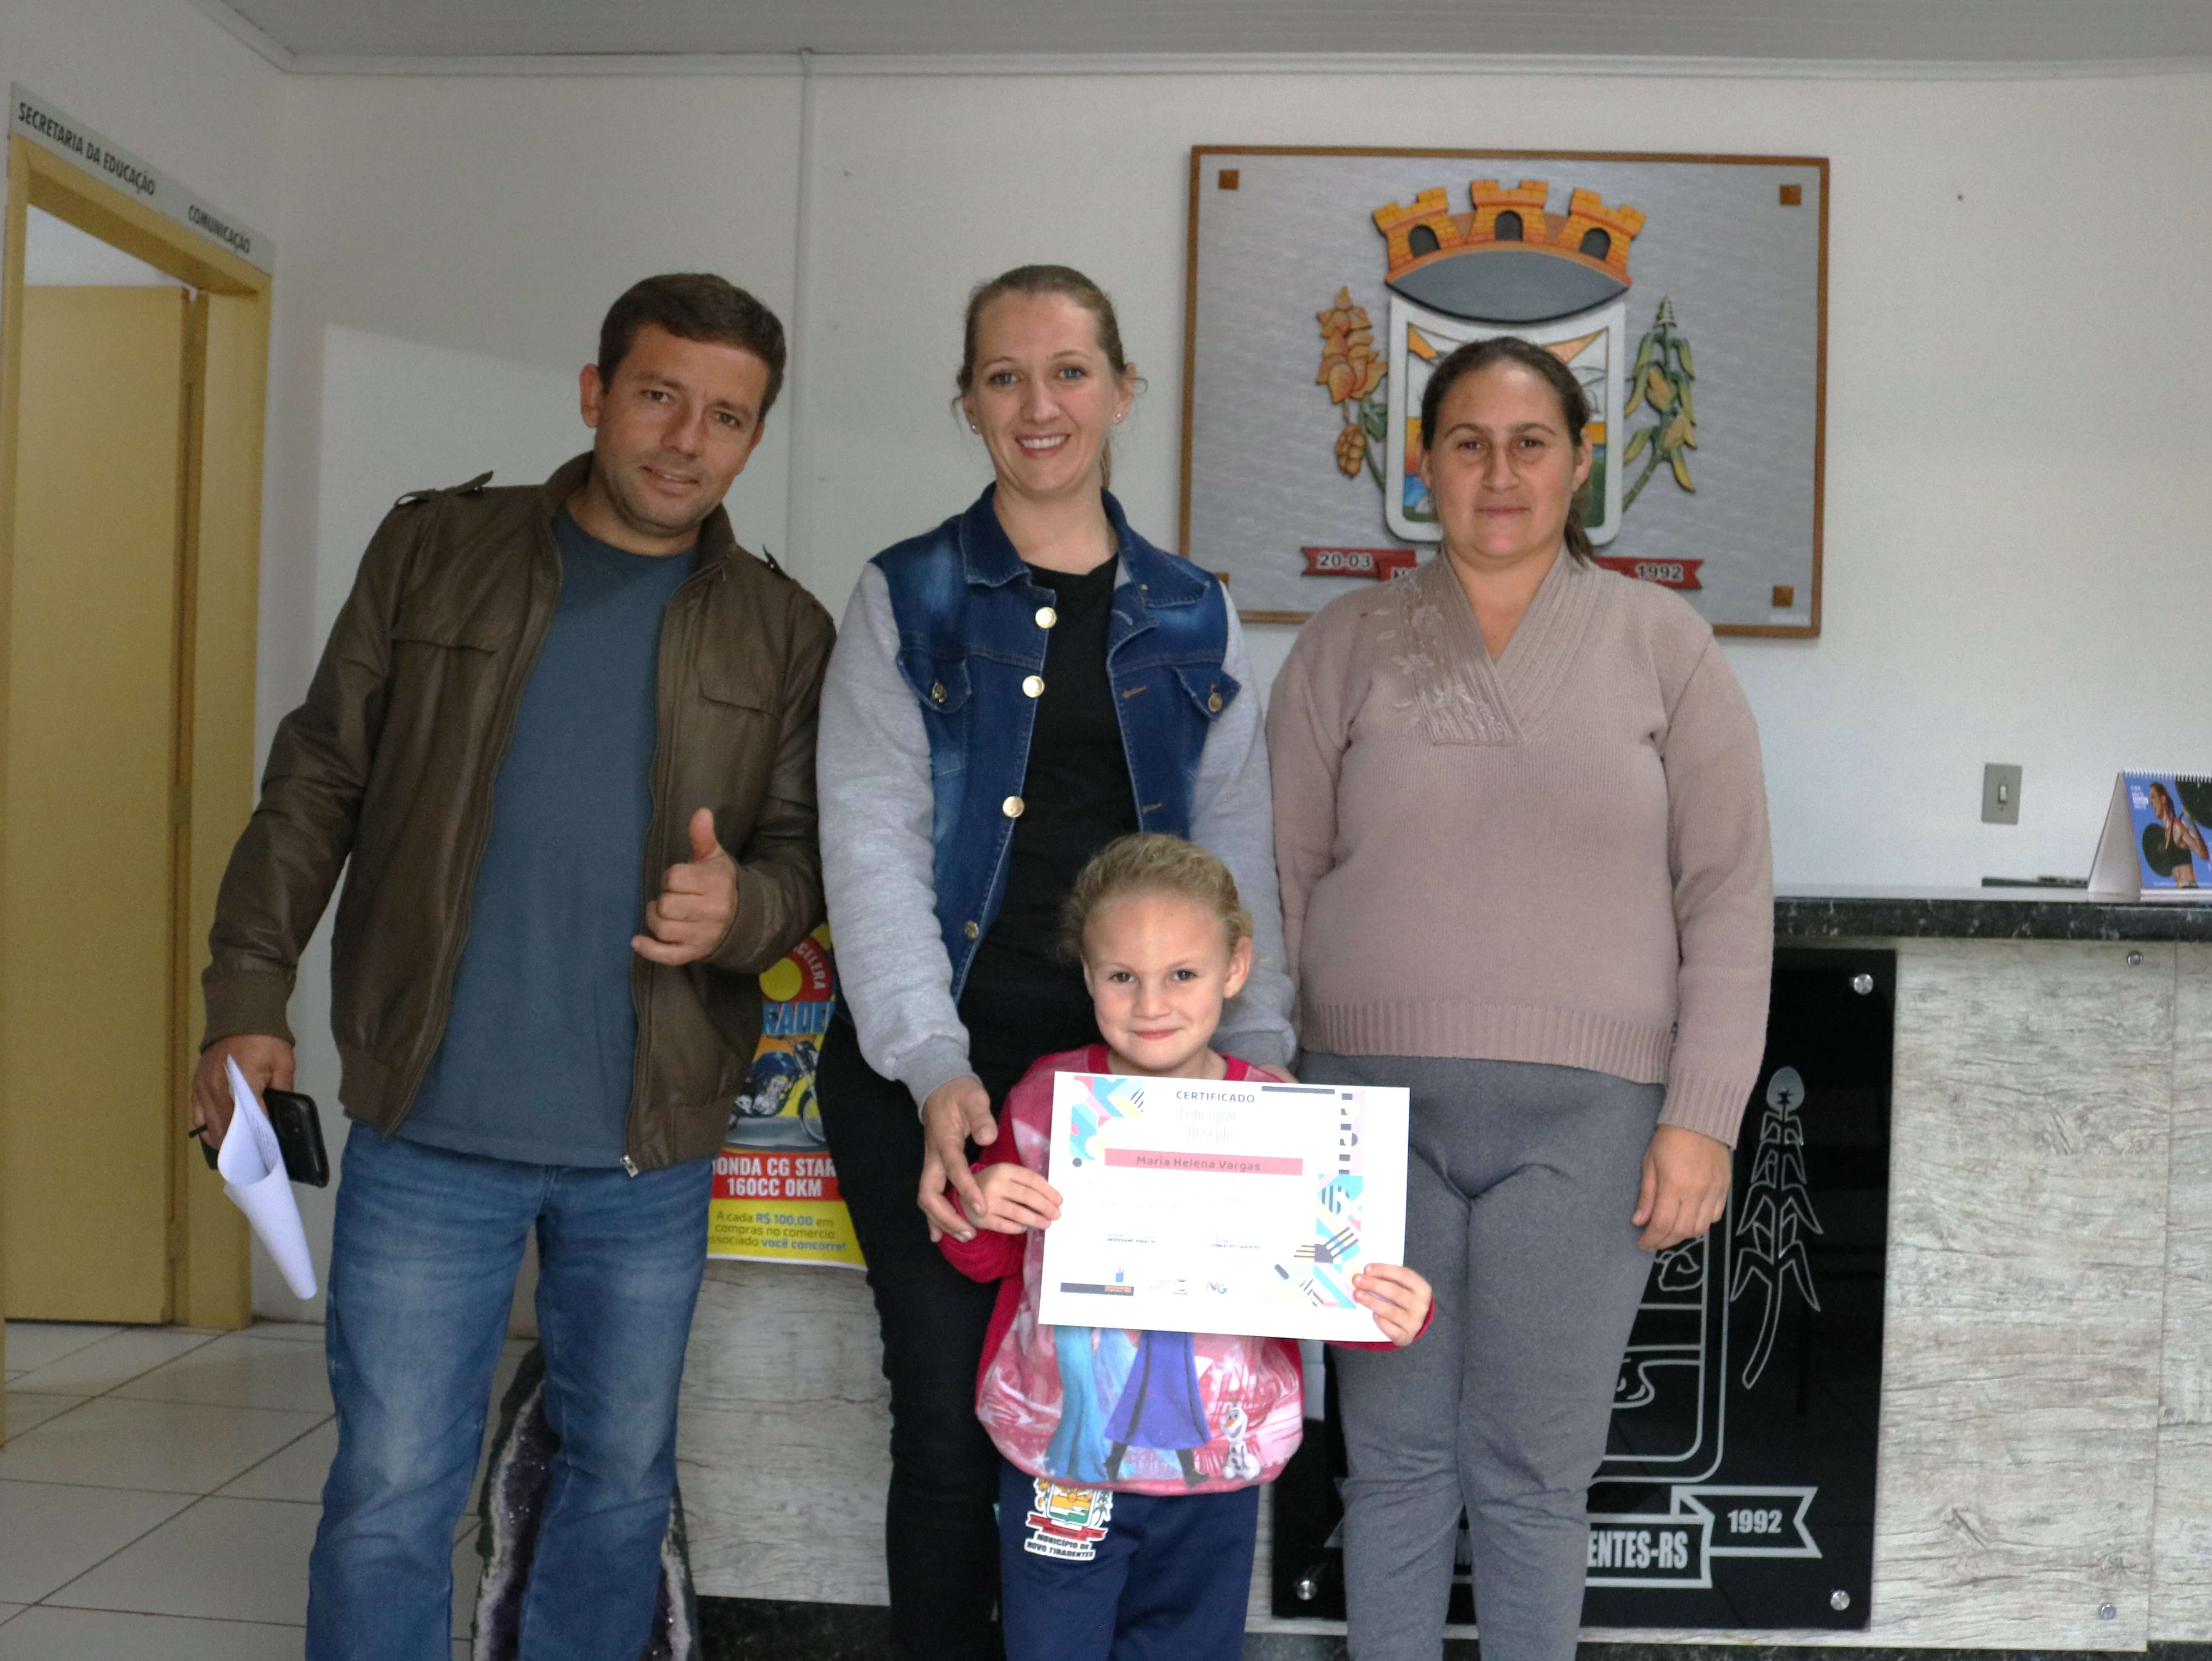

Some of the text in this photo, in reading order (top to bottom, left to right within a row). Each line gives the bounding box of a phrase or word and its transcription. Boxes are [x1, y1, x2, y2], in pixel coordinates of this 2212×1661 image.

[18, 102, 155, 196] SECRETARIA DA EDUCAÇÃO
[188, 205, 251, 254] COMUNICAÇÃO
[1637, 564, 1682, 579] 1992
[793, 941, 826, 990] CELERA
[1176, 1091, 1255, 1103] CERTIFICADO
[767, 1157, 790, 1176] CG
[1137, 1156, 1261, 1172] Maria Helena Vargas
[727, 1178, 780, 1196] 160CC
[716, 1210, 724, 1221] A
[727, 1212, 752, 1223] cada
[756, 1212, 771, 1224] R$
[775, 1214, 814, 1226] 100,00
[714, 1225, 763, 1235] compras
[1728, 1509, 1783, 1534] 1992
[1027, 1541, 1093, 1558] NOVO TIRADENTES
[1037, 1534, 1078, 1549] MUNICÍPIO
